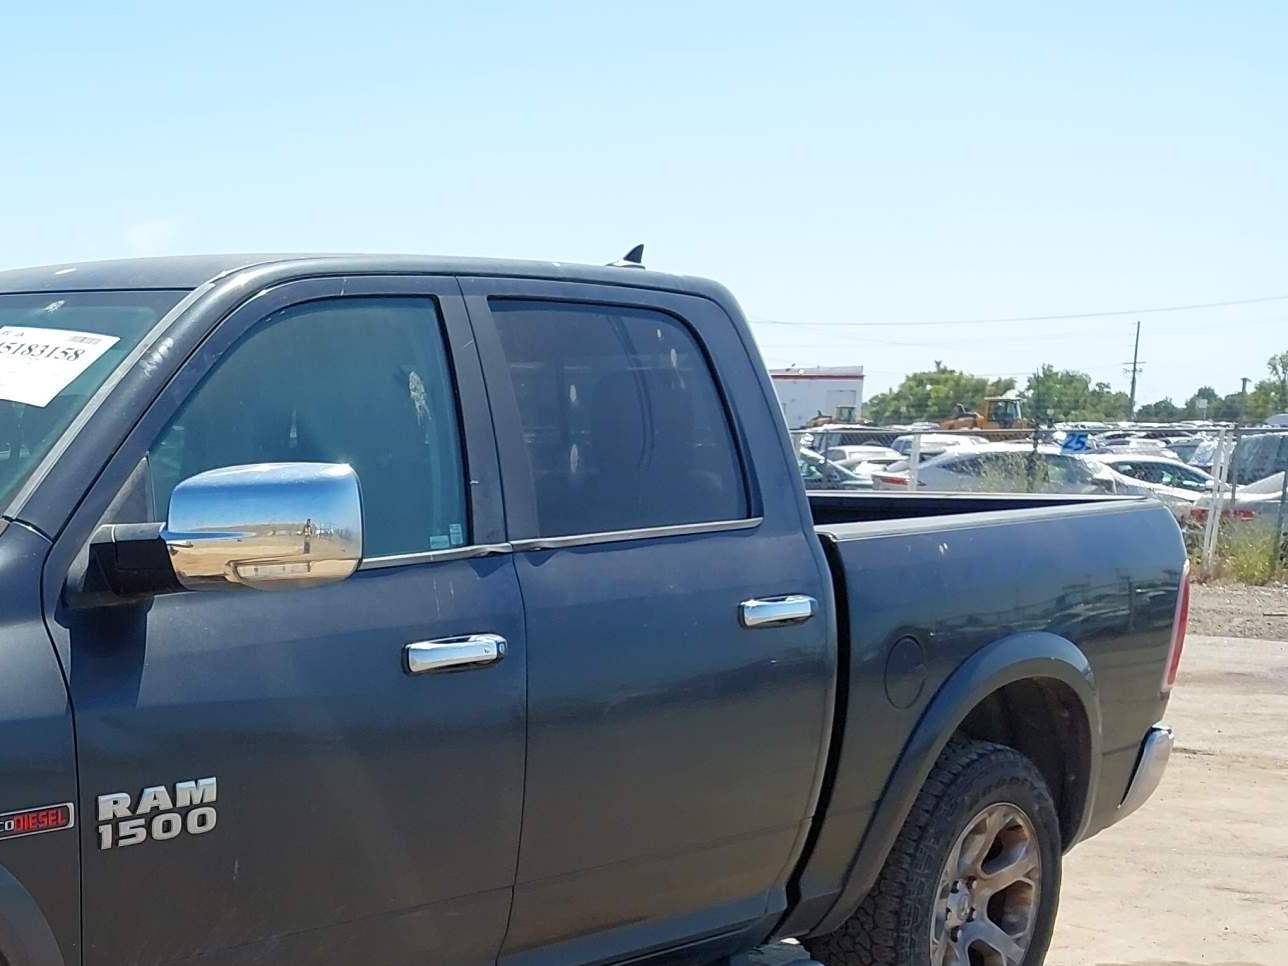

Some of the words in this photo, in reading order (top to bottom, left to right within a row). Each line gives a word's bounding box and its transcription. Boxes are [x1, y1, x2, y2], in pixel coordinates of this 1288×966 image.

[1063, 432, 1087, 451] 25
[98, 776, 217, 821] RAM
[98, 806, 217, 850] 1500
